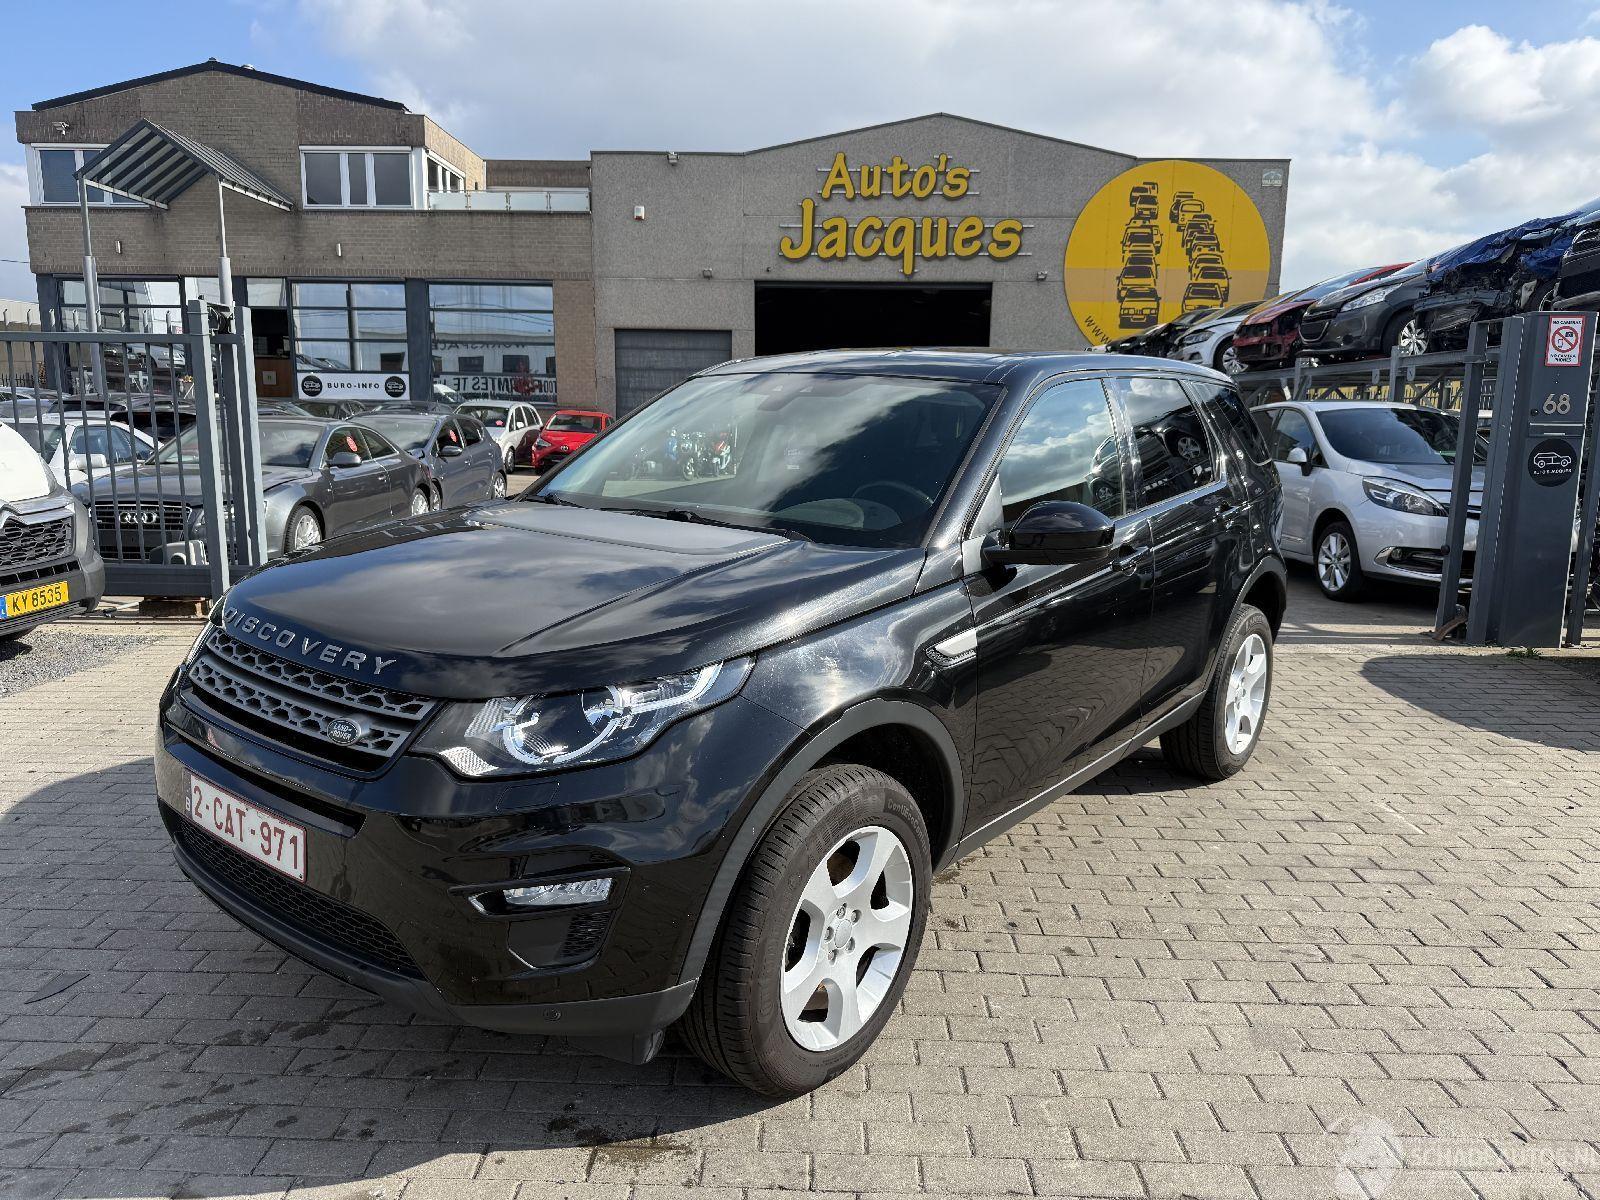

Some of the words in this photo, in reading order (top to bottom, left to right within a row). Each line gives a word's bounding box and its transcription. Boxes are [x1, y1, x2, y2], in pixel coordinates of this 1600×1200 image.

[821, 152, 971, 200] Auto's
[780, 198, 1024, 276] Jacques
[1542, 393, 1571, 415] 68
[12, 594, 28, 612] KY
[31, 586, 62, 607] 8535
[224, 606, 397, 675] DISCOVERY
[333, 721, 349, 732] LAND
[185, 796, 191, 811] B
[193, 785, 298, 869] 2-CAT-971
